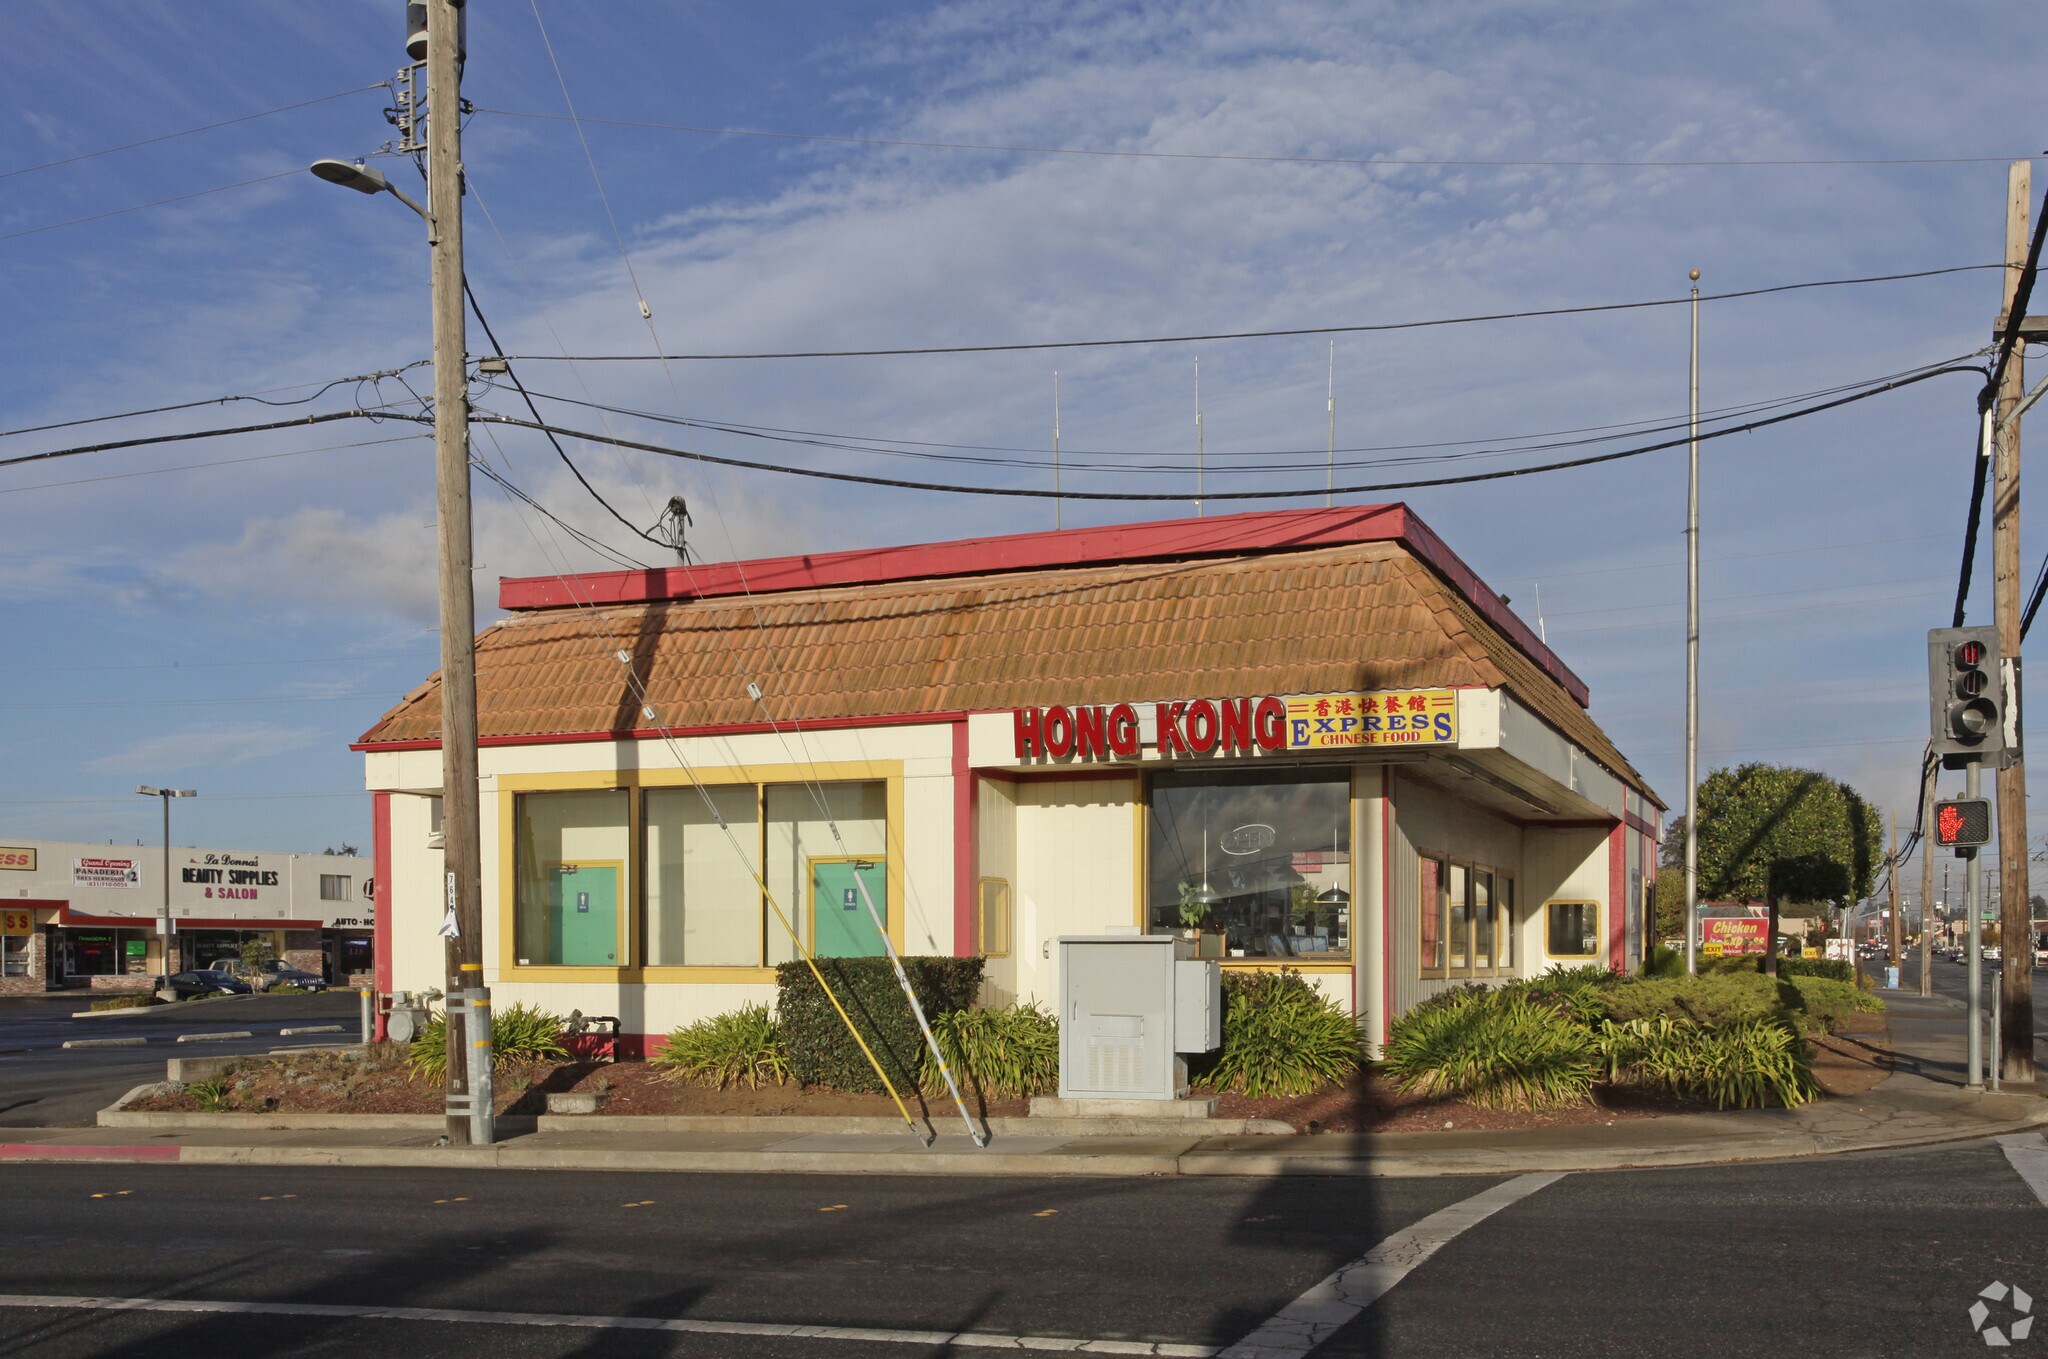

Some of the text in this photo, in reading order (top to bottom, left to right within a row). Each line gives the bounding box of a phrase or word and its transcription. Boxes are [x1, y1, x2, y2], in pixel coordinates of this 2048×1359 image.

[1312, 694, 1428, 717] 香港快餐館
[1013, 696, 1287, 758] HONG KONG
[1290, 712, 1453, 747] EXPRESS
[1320, 731, 1421, 746] CHINESE FOOD
[82, 859, 131, 868] Grand Opening
[204, 853, 219, 865] La
[75, 868, 125, 876] PANADERIA
[182, 867, 279, 886] BEAUTY SUPPLIES
[204, 887, 258, 900] & SALON
[335, 918, 358, 926] AUTO
[1712, 920, 1758, 934] Chicken
